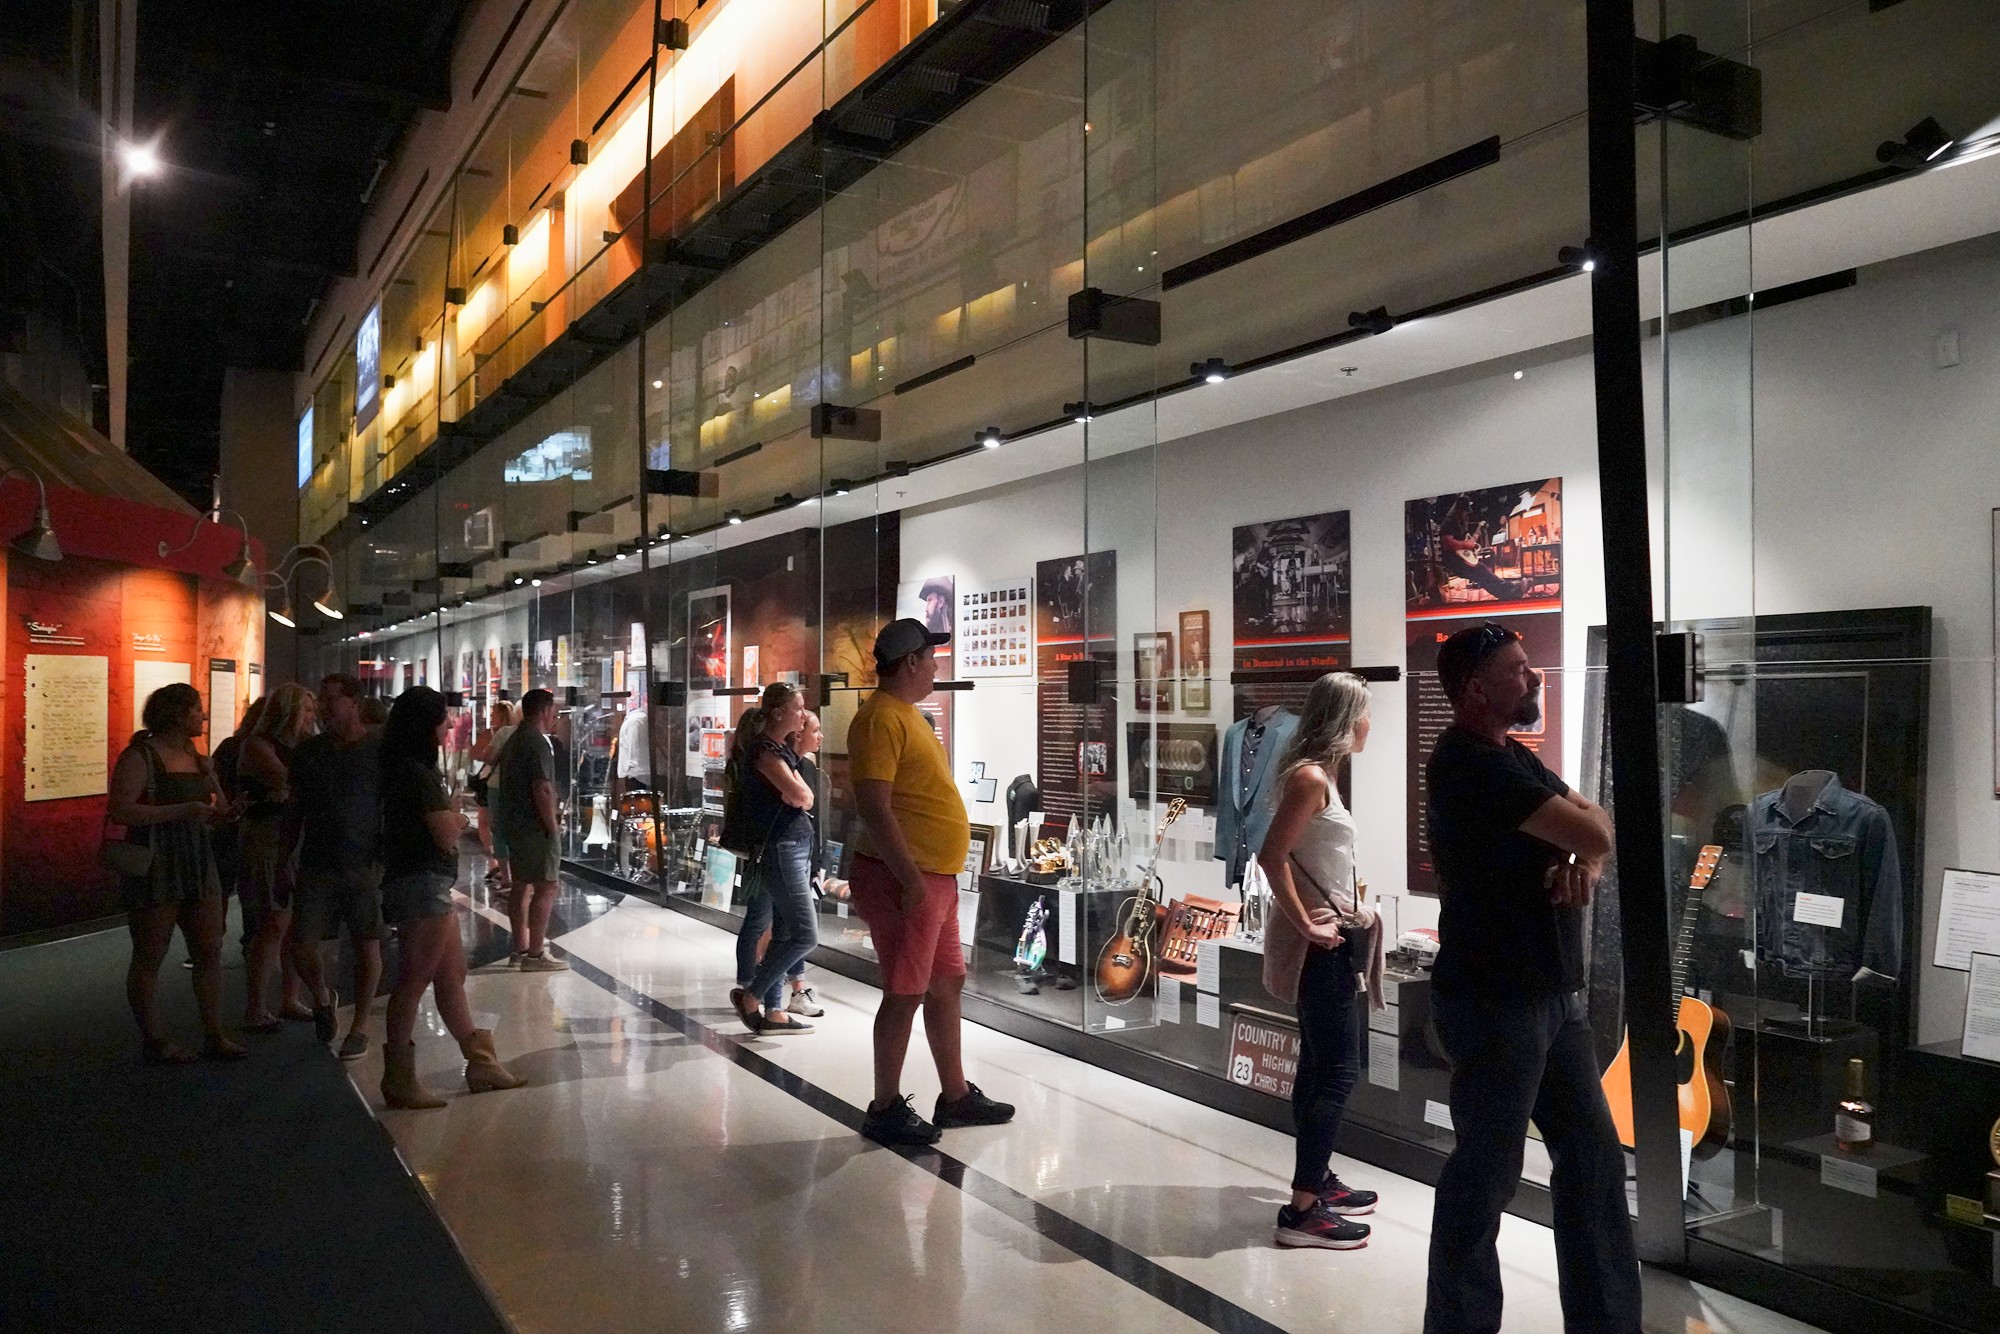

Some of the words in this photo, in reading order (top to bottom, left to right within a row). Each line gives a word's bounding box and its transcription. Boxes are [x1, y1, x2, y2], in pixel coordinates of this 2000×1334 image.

[1253, 658, 1283, 668] Demand
[1296, 657, 1309, 666] the
[1311, 656, 1338, 666] Studio
[1238, 1024, 1287, 1051] COUNTRY
[1291, 1038, 1301, 1056] M
[1236, 1062, 1249, 1080] 23
[1262, 1053, 1297, 1075] HIGHWA
[1254, 1073, 1277, 1091] CHRIS
